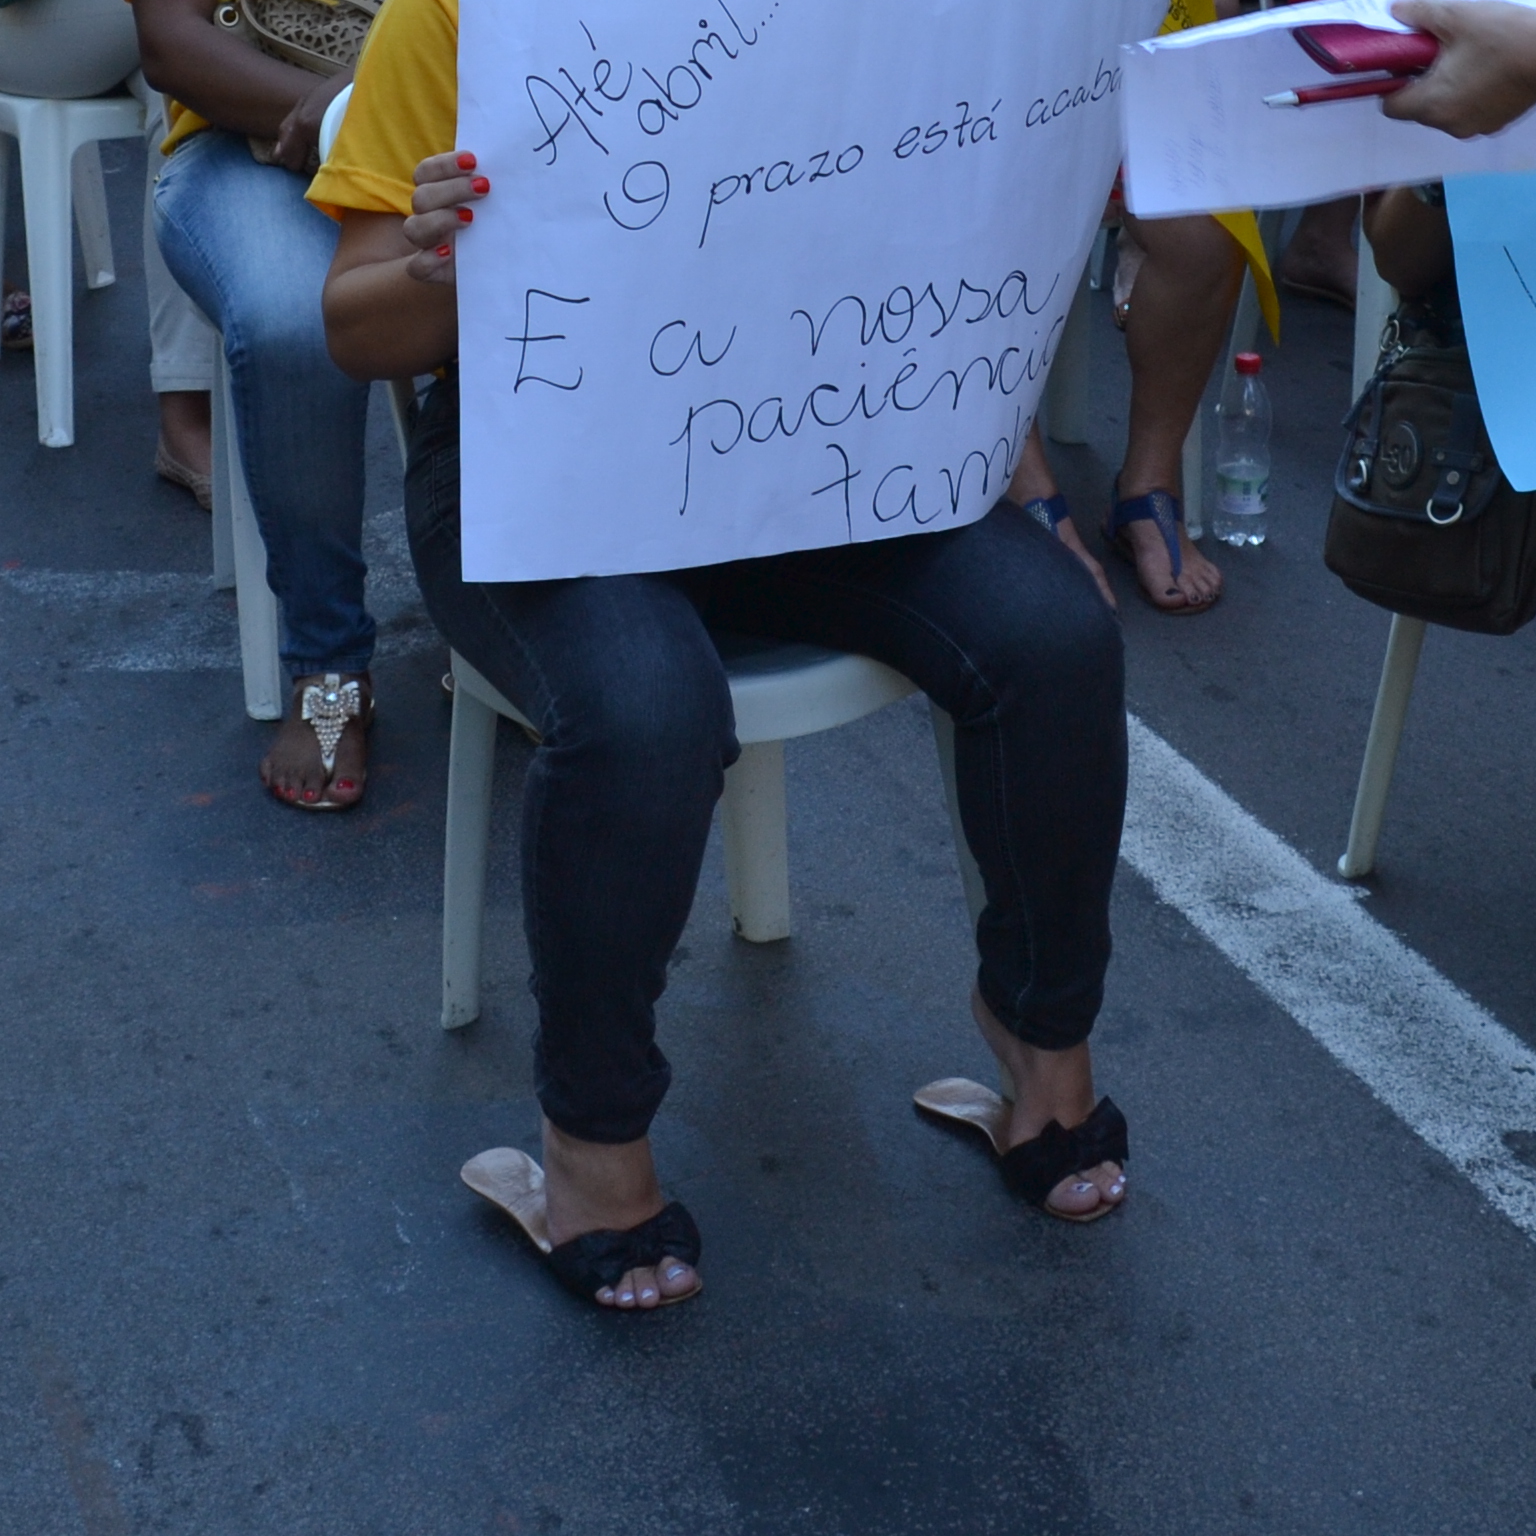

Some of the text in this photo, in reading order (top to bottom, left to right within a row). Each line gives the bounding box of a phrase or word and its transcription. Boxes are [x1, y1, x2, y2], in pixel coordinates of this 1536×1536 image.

[526, 20, 633, 166] Até
[603, 160, 670, 231] O
[699, 144, 864, 249] prazo
[894, 98, 1002, 159] está
[504, 270, 1061, 393] E a nossa
